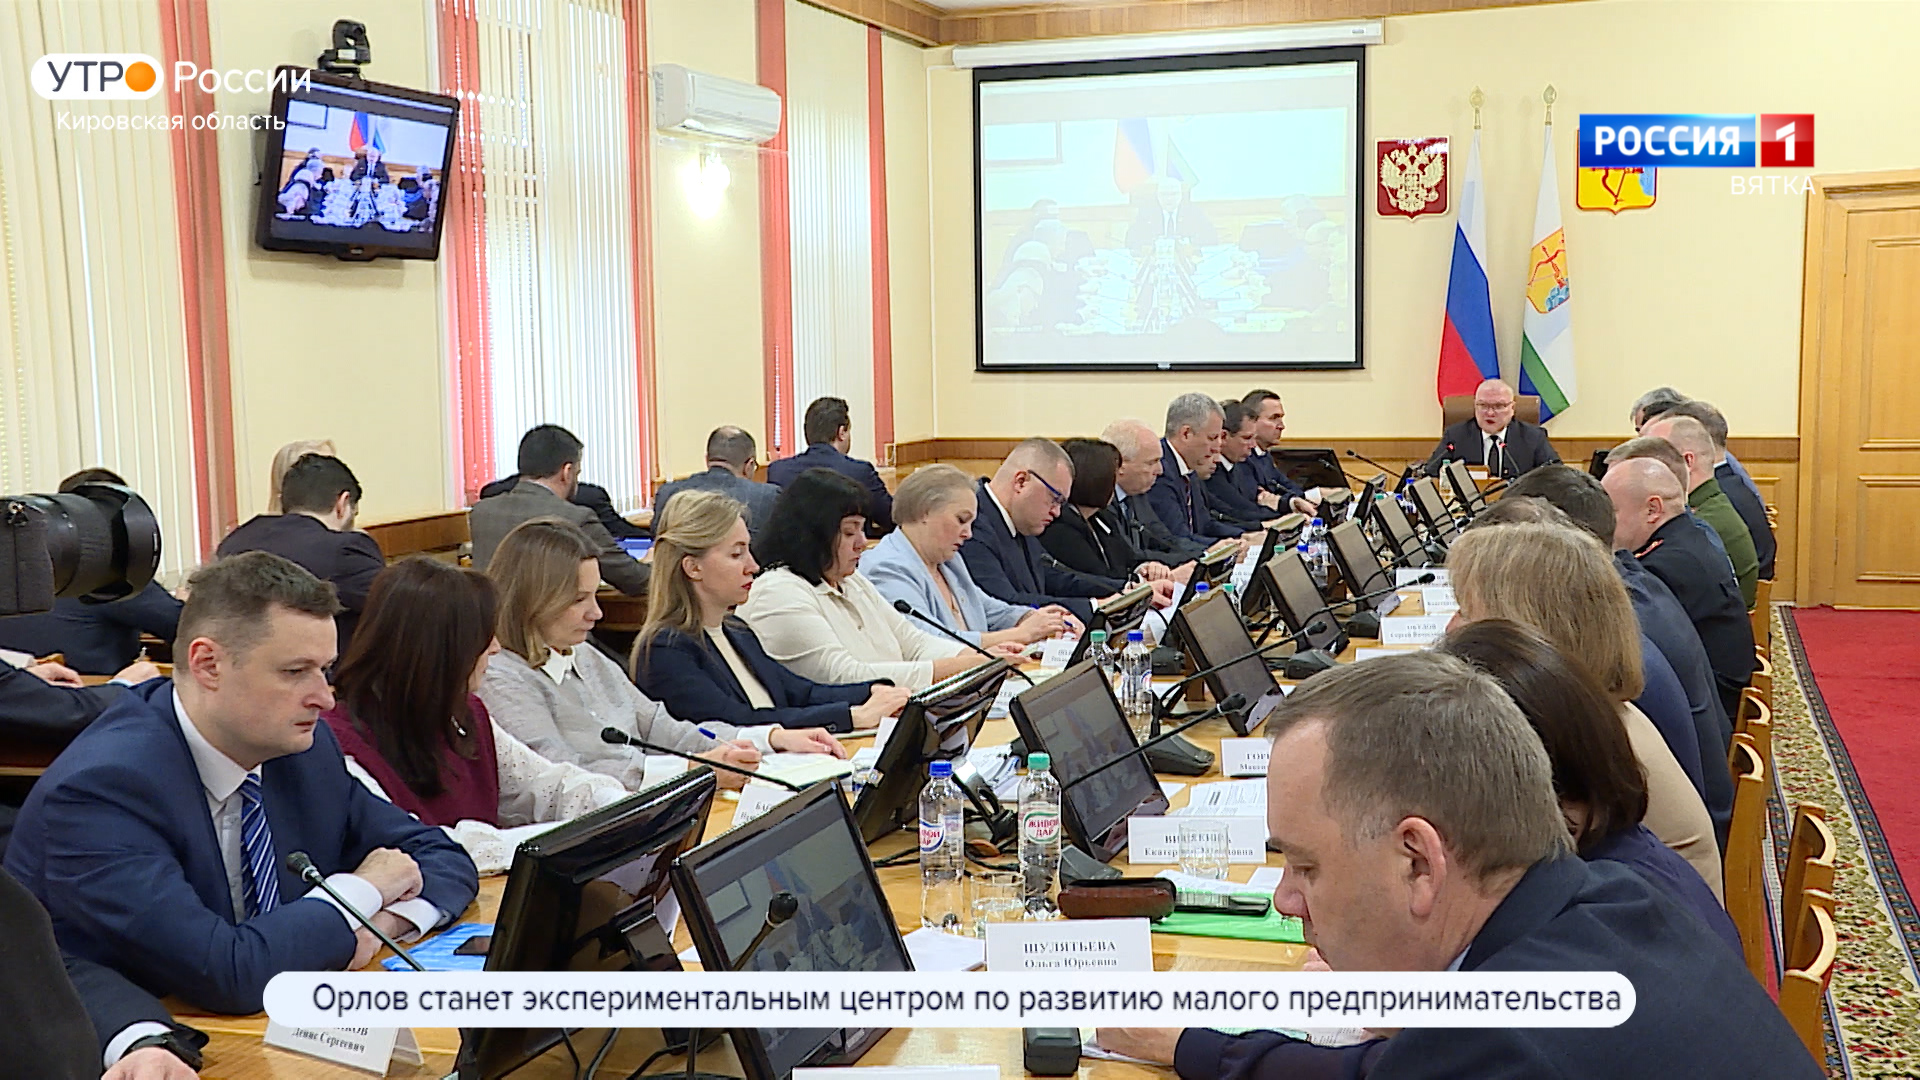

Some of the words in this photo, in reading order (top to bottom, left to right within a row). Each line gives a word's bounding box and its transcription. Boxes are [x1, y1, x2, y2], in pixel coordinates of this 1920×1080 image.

[1024, 941, 1117, 954] ШУЛЯТЬЕВА
[1024, 959, 1061, 968] Ольга
[1064, 957, 1117, 969] Юрьевна
[319, 1031, 366, 1054] Сергеевич
